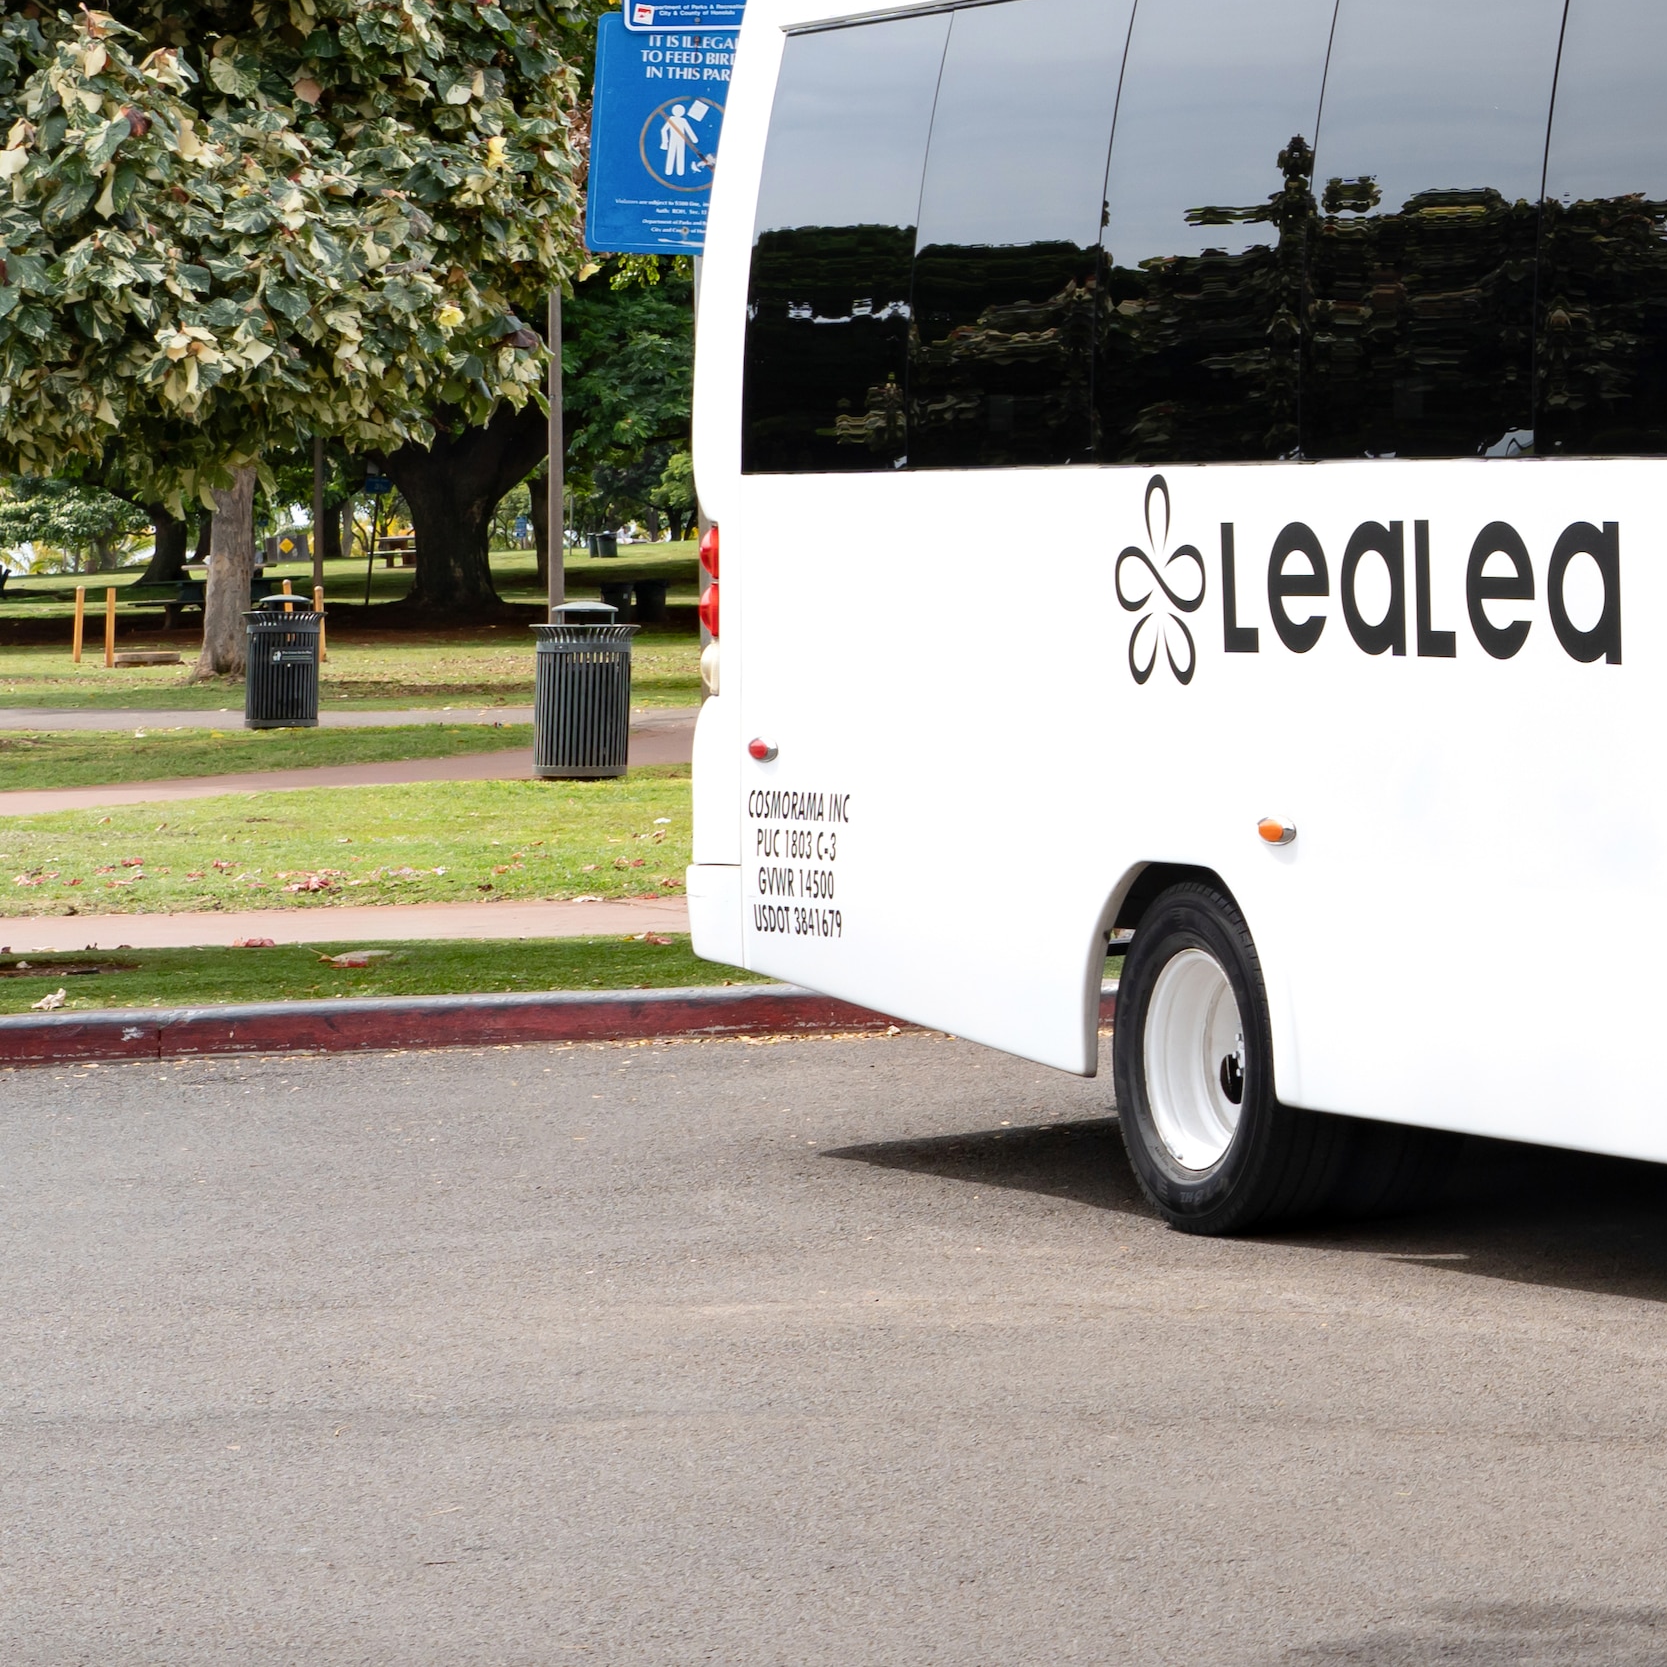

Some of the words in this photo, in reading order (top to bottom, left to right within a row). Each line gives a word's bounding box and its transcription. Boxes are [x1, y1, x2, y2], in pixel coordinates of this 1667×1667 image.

[641, 50, 663, 63] TO
[665, 51, 703, 64] FEED
[705, 52, 736, 65] BIR
[649, 35, 664, 46] IT
[666, 35, 679, 47] IS
[646, 66, 663, 78] IN
[666, 67, 700, 80] THIS
[703, 68, 730, 81] PAR
[749, 790, 824, 821] COSMORAMA
[829, 794, 850, 823] INC
[757, 828, 780, 858] PUC
[786, 830, 812, 859] 1803
[817, 832, 836, 861] C-3
[759, 866, 794, 896] GVWR
[800, 869, 834, 899] 14500
[754, 904, 790, 934] USDOT
[794, 907, 842, 938] 3841679
